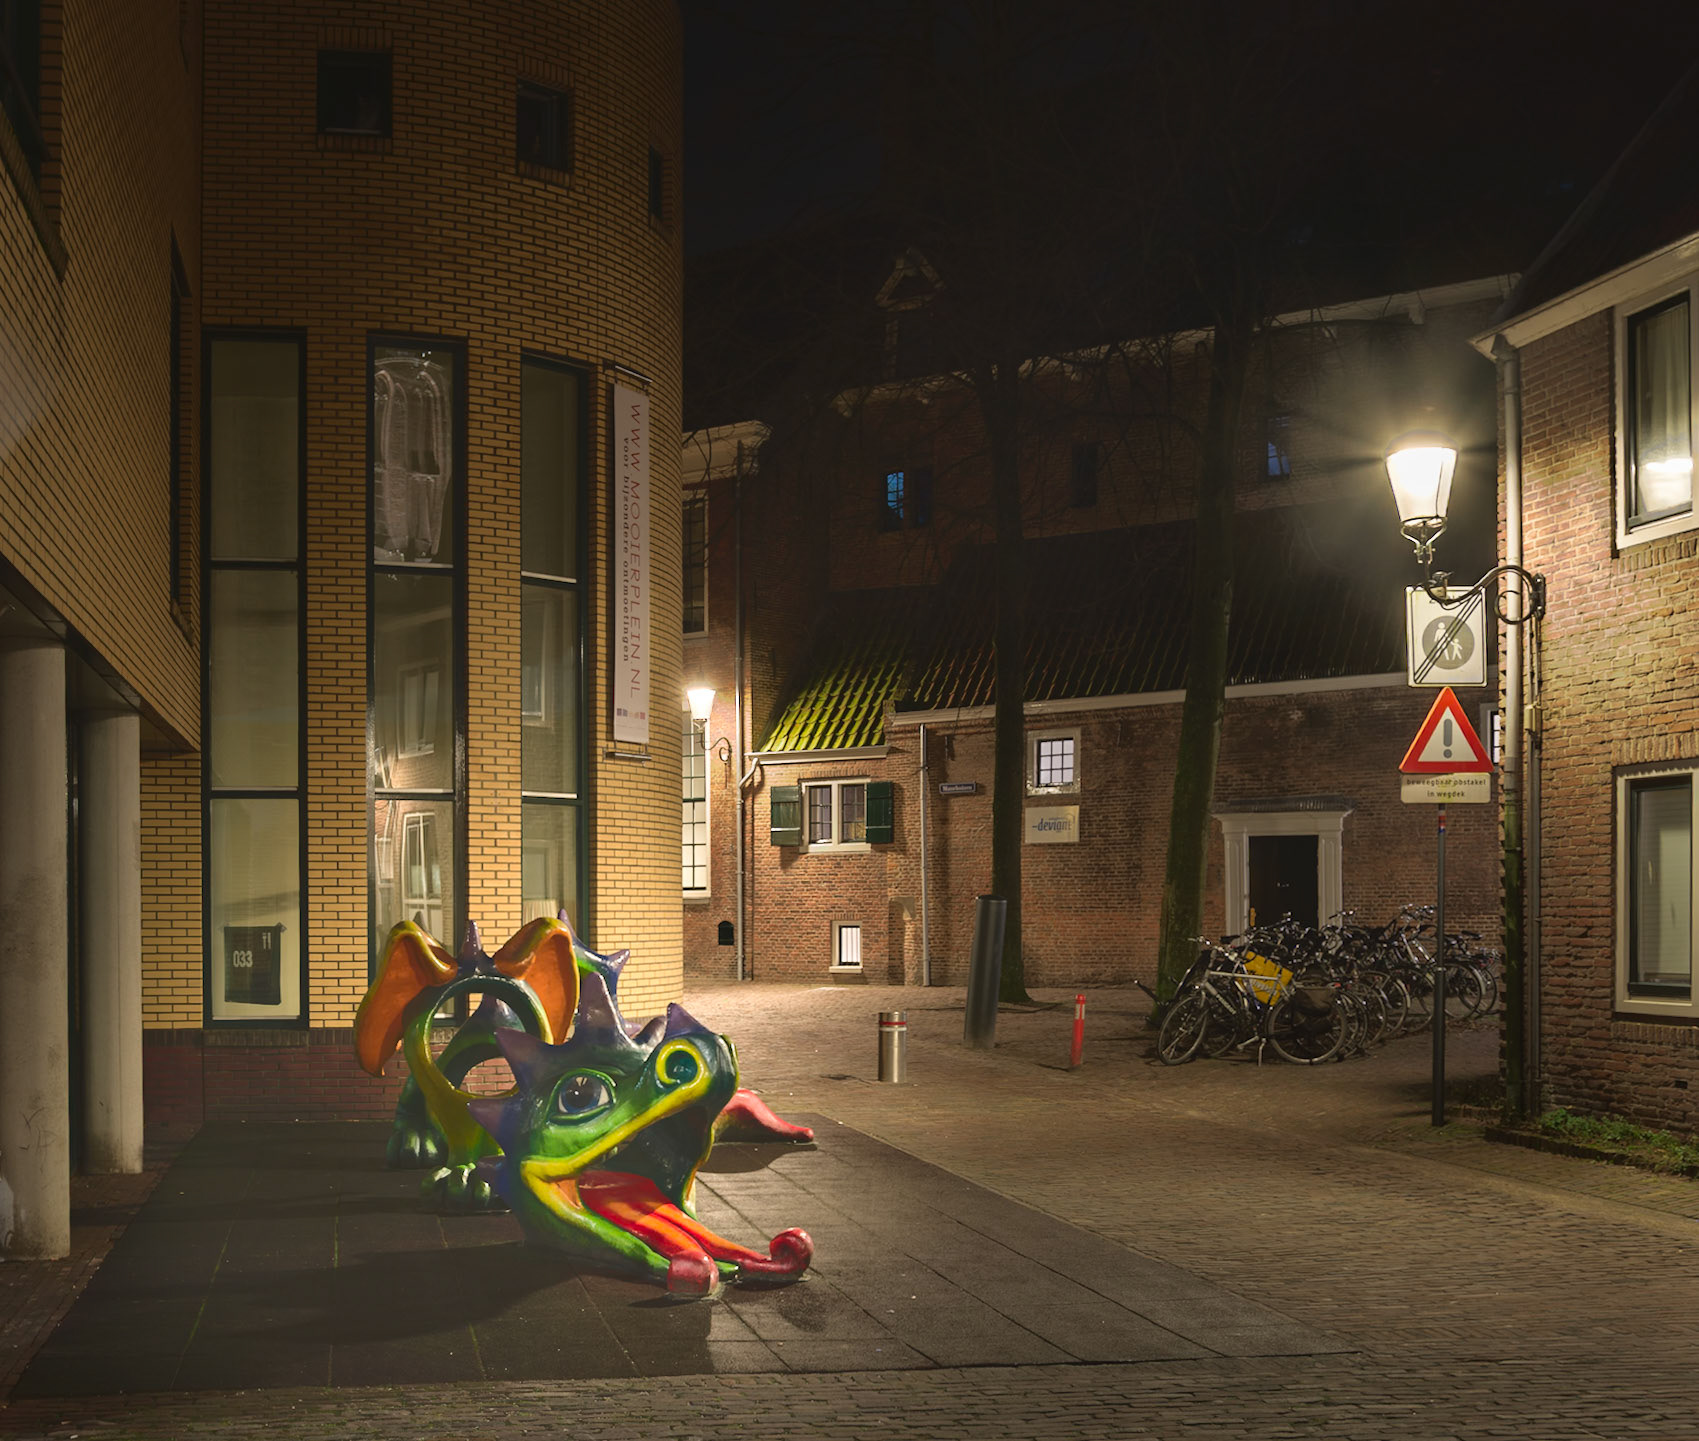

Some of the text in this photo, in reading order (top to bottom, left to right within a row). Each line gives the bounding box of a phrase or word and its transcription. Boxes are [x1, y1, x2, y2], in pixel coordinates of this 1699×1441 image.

[622, 475, 630, 554] bijzondere
[630, 404, 641, 699] WWW.MOOIERPLEIN.NL
[1453, 778, 1487, 787] obstakel
[1427, 790, 1465, 799] in wegdek
[232, 950, 253, 968] 033
